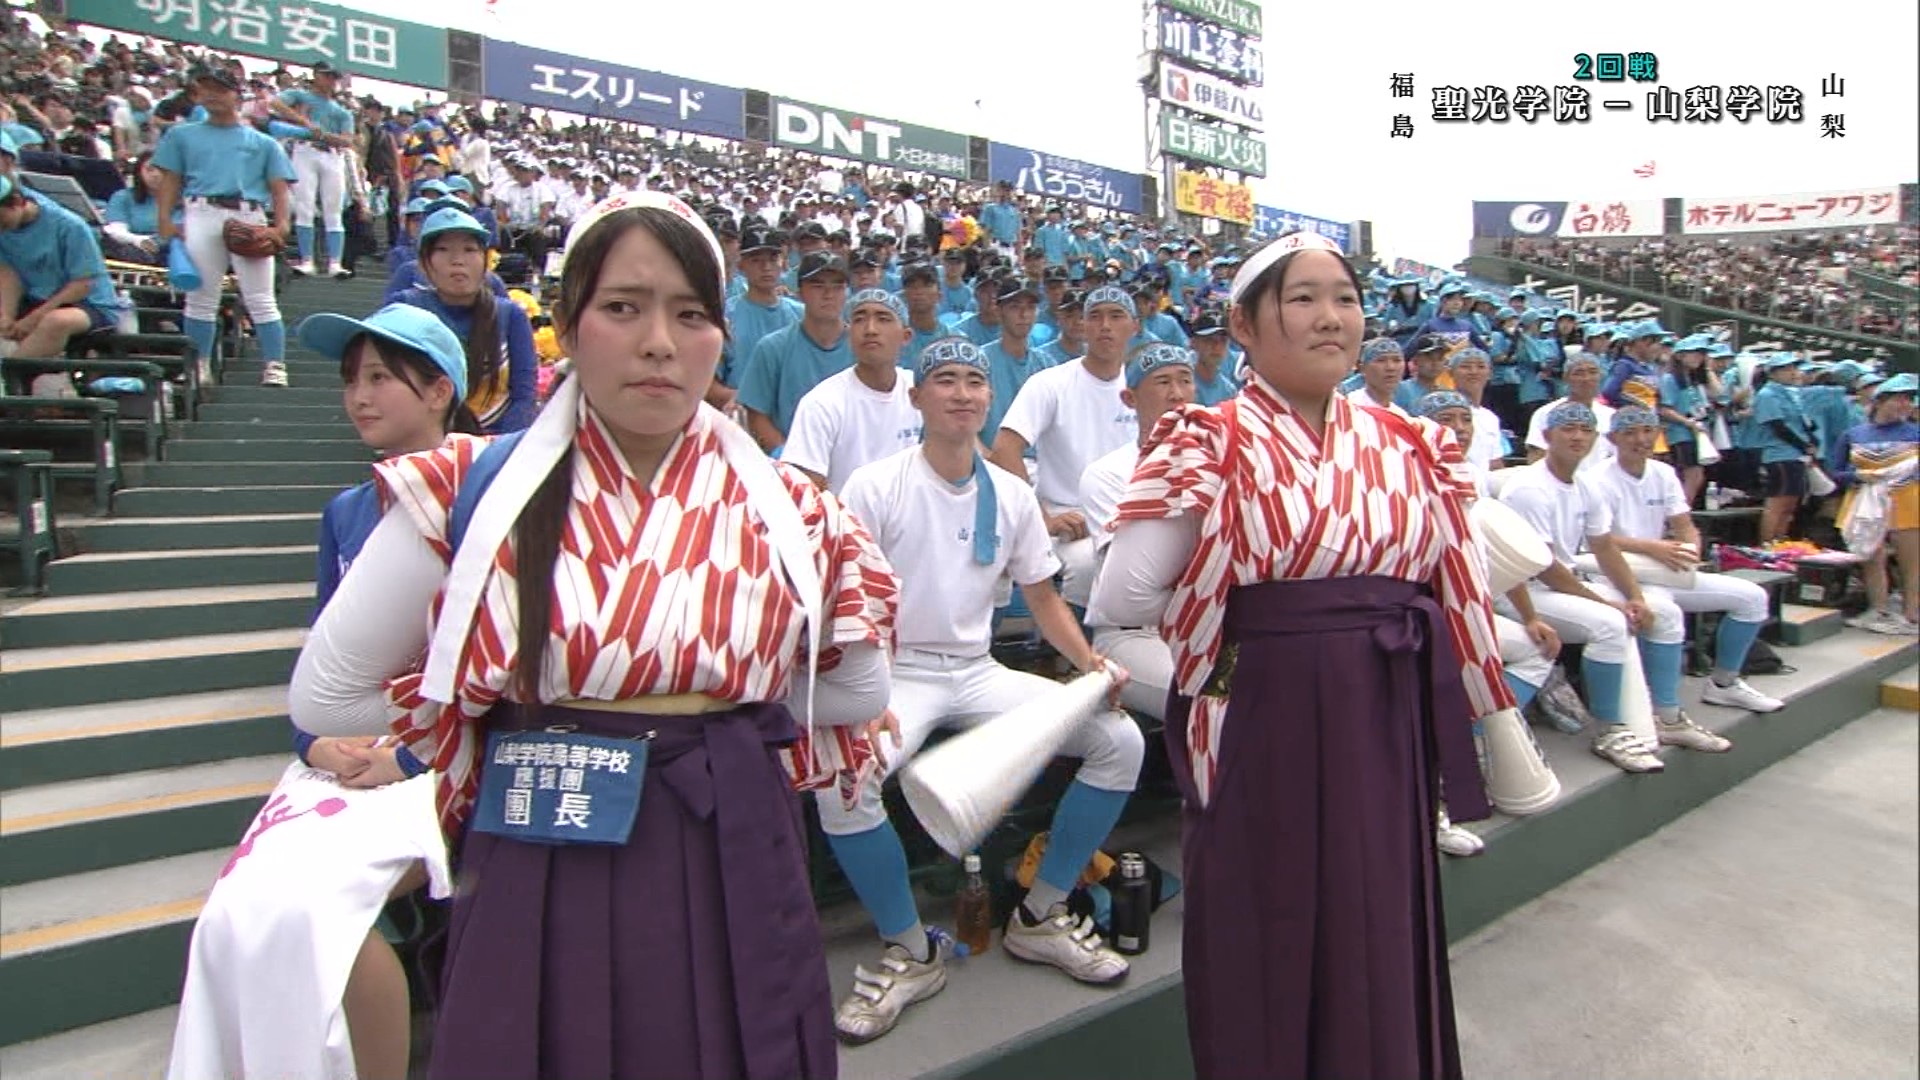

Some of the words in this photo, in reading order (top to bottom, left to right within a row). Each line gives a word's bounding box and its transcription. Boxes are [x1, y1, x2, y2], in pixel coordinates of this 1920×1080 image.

[530, 64, 704, 119] エスリード
[777, 103, 901, 159] DNT
[1169, 118, 1264, 172] 日新火災
[1045, 169, 1123, 206] ろうきん
[1687, 193, 1893, 226] ホテルニューアワジ
[494, 741, 632, 774] 山梨学院高等学校
